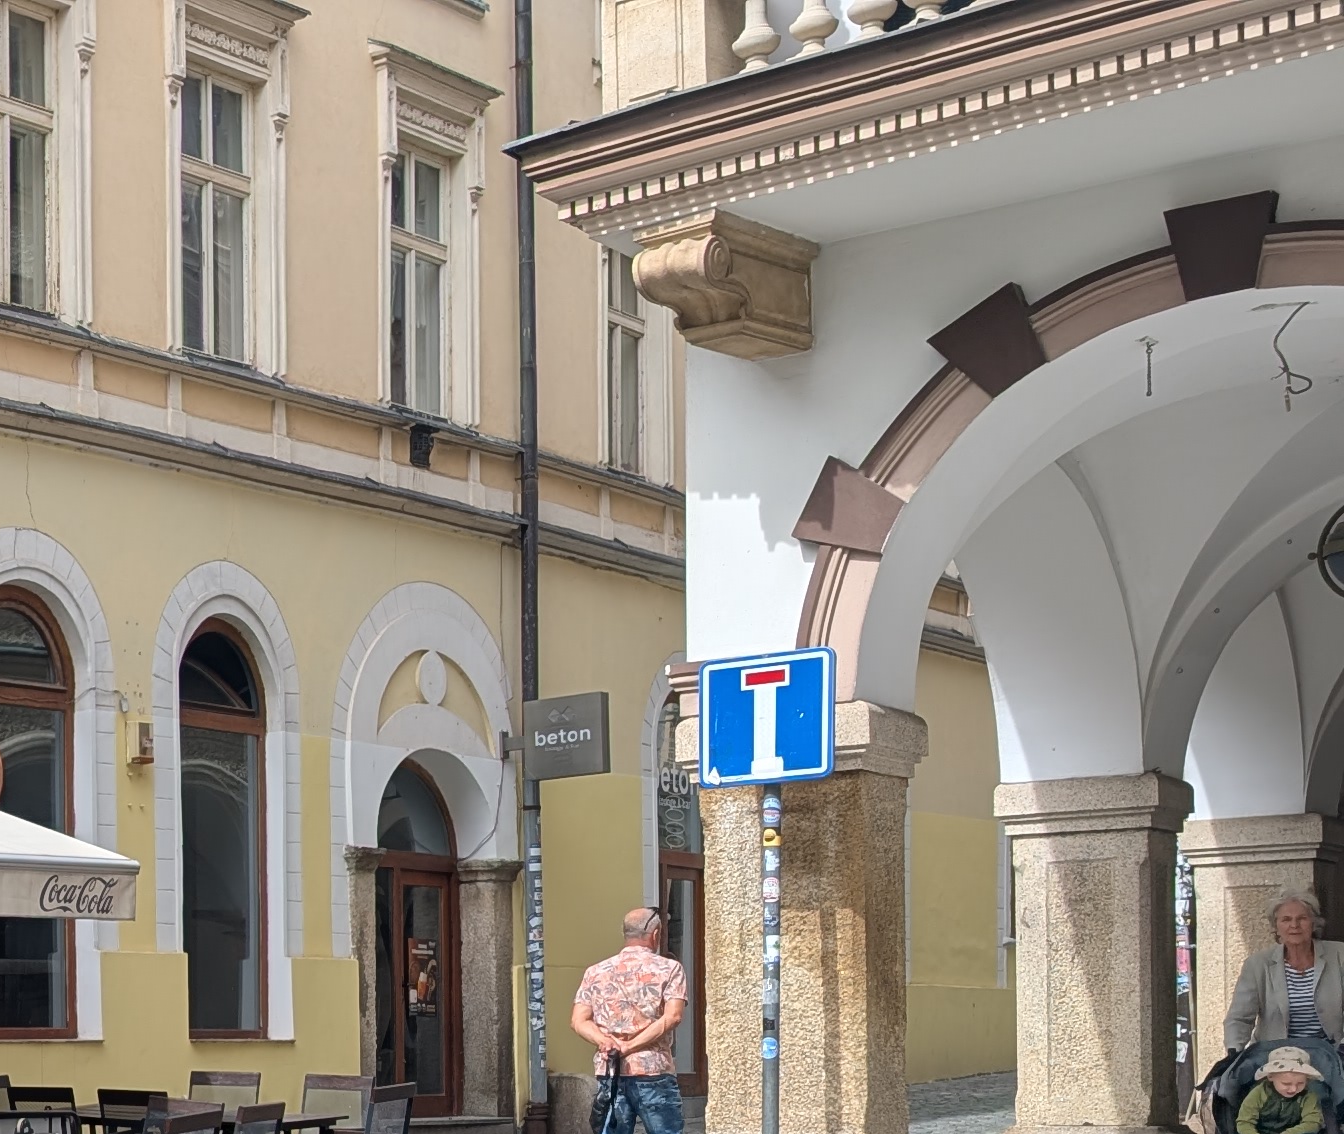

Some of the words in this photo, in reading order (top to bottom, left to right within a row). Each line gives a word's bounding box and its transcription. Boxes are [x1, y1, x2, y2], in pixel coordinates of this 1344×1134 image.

[535, 728, 591, 748] beton
[657, 762, 699, 796] eto
[39, 874, 119, 917] Coca-Cola
